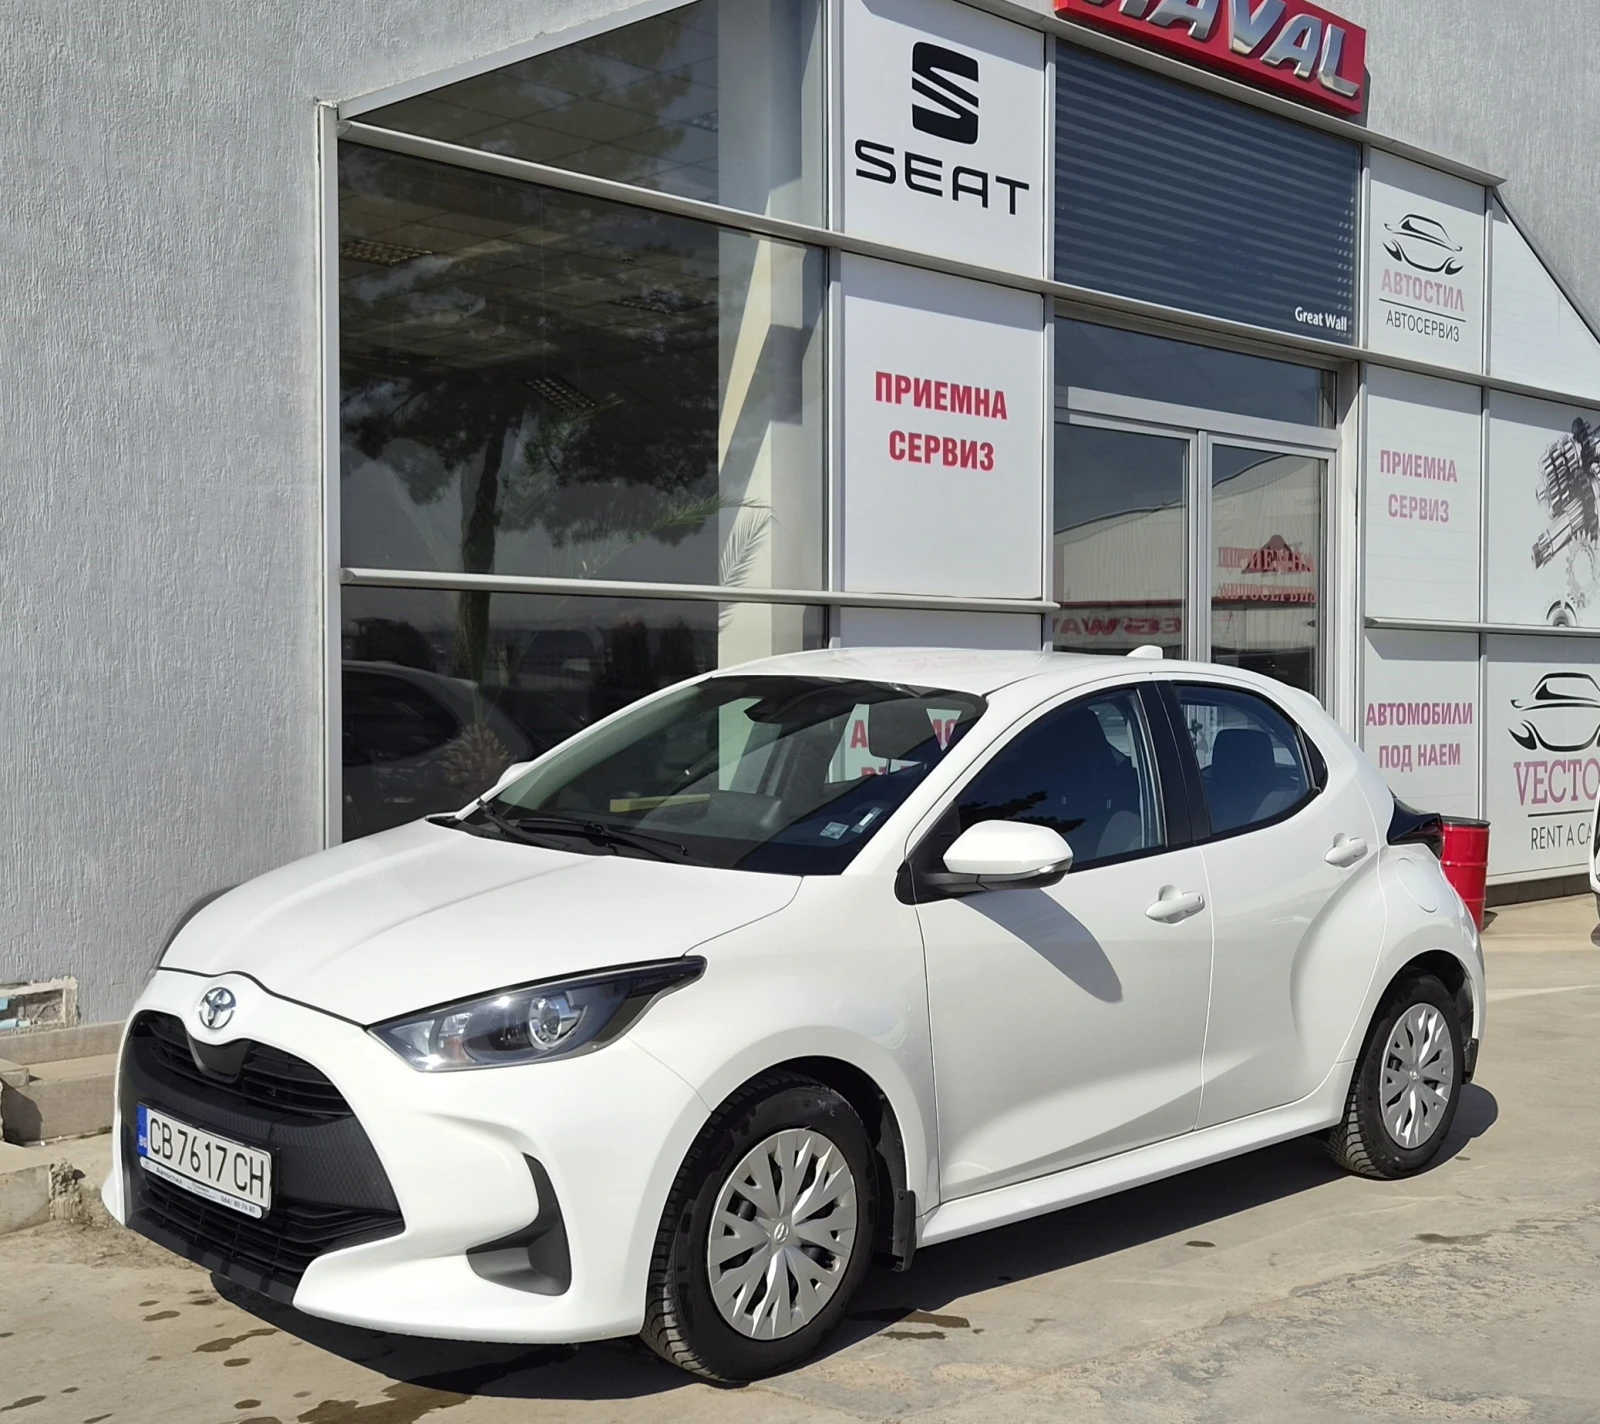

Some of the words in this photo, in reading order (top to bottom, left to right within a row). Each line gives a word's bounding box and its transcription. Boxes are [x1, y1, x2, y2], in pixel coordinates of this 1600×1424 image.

[1081, 0, 1360, 97] AVAL
[855, 139, 1030, 216] SEAT
[1381, 268, 1465, 312] АВТОСТИЛ
[1294, 305, 1324, 327] Great
[1324, 312, 1347, 332] Wall
[1386, 309, 1460, 342] АВТОСЕРВИЗ
[875, 370, 1008, 420] ПРИЕМНА
[889, 430, 994, 471] СЕРВИЗ
[1380, 449, 1458, 483] ПРИЕМНА
[1388, 493, 1449, 523] СЕРВИЗ
[1366, 702, 1473, 726] АВТОМОБИЛИ
[1379, 745, 1413, 772] ПОД
[1417, 743, 1461, 767] НАЕМ
[1531, 825, 1563, 850] RENT
[1566, 824, 1575, 846] A
